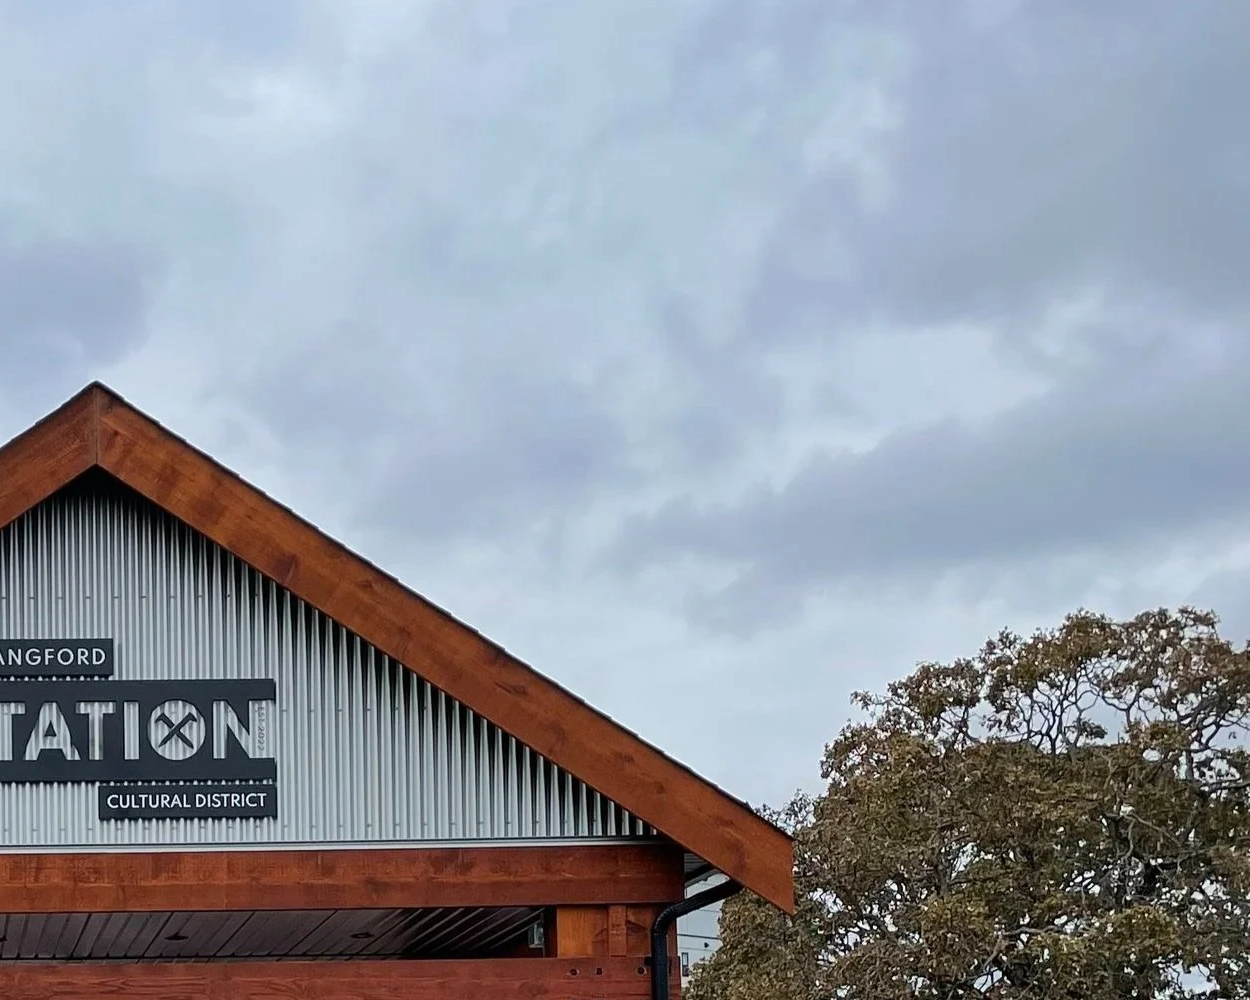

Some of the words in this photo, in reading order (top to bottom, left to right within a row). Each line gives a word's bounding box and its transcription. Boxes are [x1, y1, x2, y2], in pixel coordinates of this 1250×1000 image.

[257, 726, 265, 751] 2022
[106, 794, 191, 809] CULTURAL
[195, 793, 267, 808] DISTRICT
